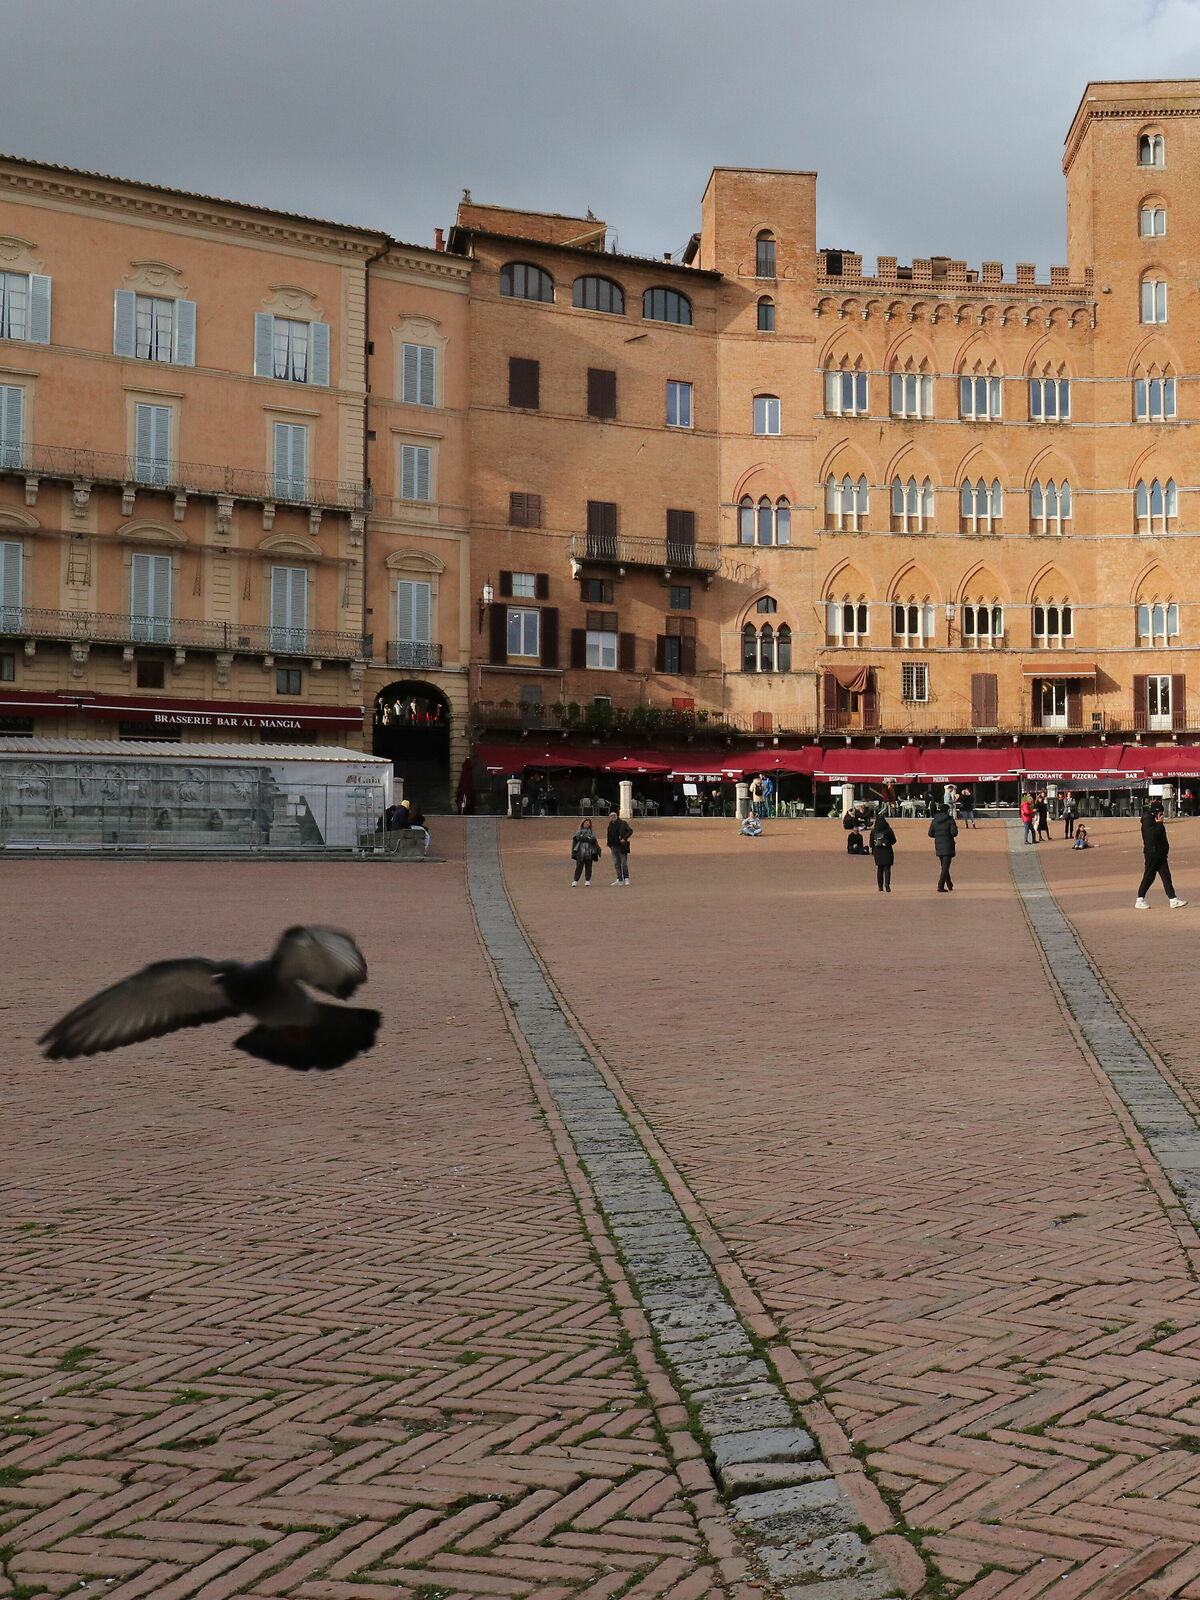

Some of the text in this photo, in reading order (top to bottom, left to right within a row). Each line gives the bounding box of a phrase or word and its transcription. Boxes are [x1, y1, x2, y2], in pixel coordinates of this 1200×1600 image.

[154, 714, 301, 728] BRASSERIE BAR AL MANGIA
